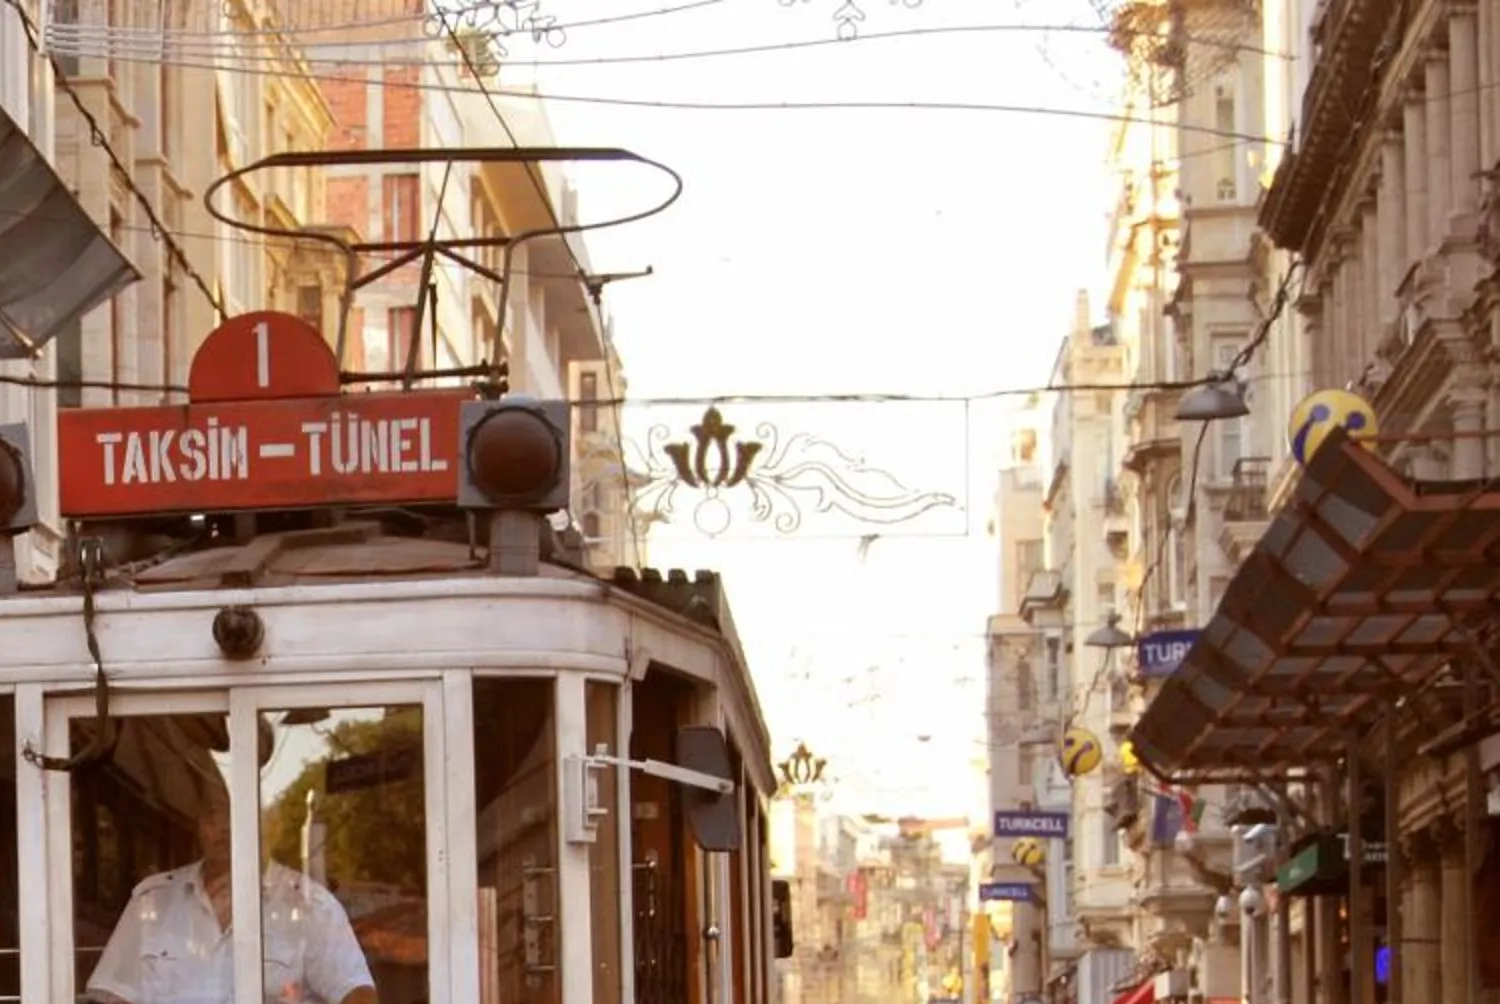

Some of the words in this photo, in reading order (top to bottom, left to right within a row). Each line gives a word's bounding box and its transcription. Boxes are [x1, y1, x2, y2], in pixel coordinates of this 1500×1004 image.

[252, 322, 269, 388] 1
[97, 417, 248, 485] TAKSİM
[302, 411, 447, 476] TÜNEL
[999, 817, 1064, 831] TURKCELL
